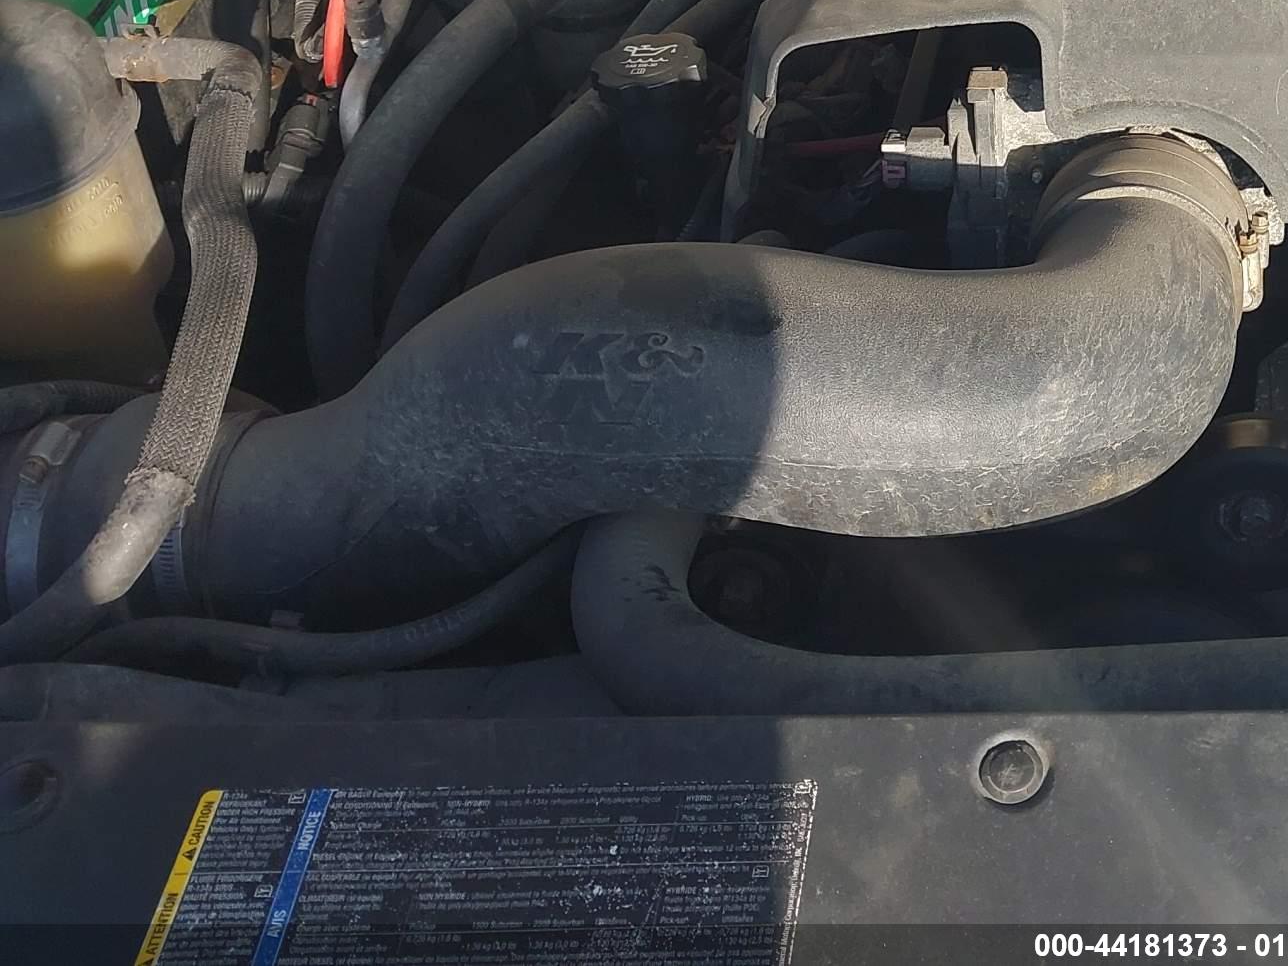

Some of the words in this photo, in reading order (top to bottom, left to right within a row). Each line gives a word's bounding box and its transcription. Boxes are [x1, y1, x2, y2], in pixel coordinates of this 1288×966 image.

[189, 801, 215, 846] CAUTION
[297, 810, 322, 851] NOTICE
[145, 892, 179, 956] ATTENTION
[267, 909, 287, 938] AVIS
